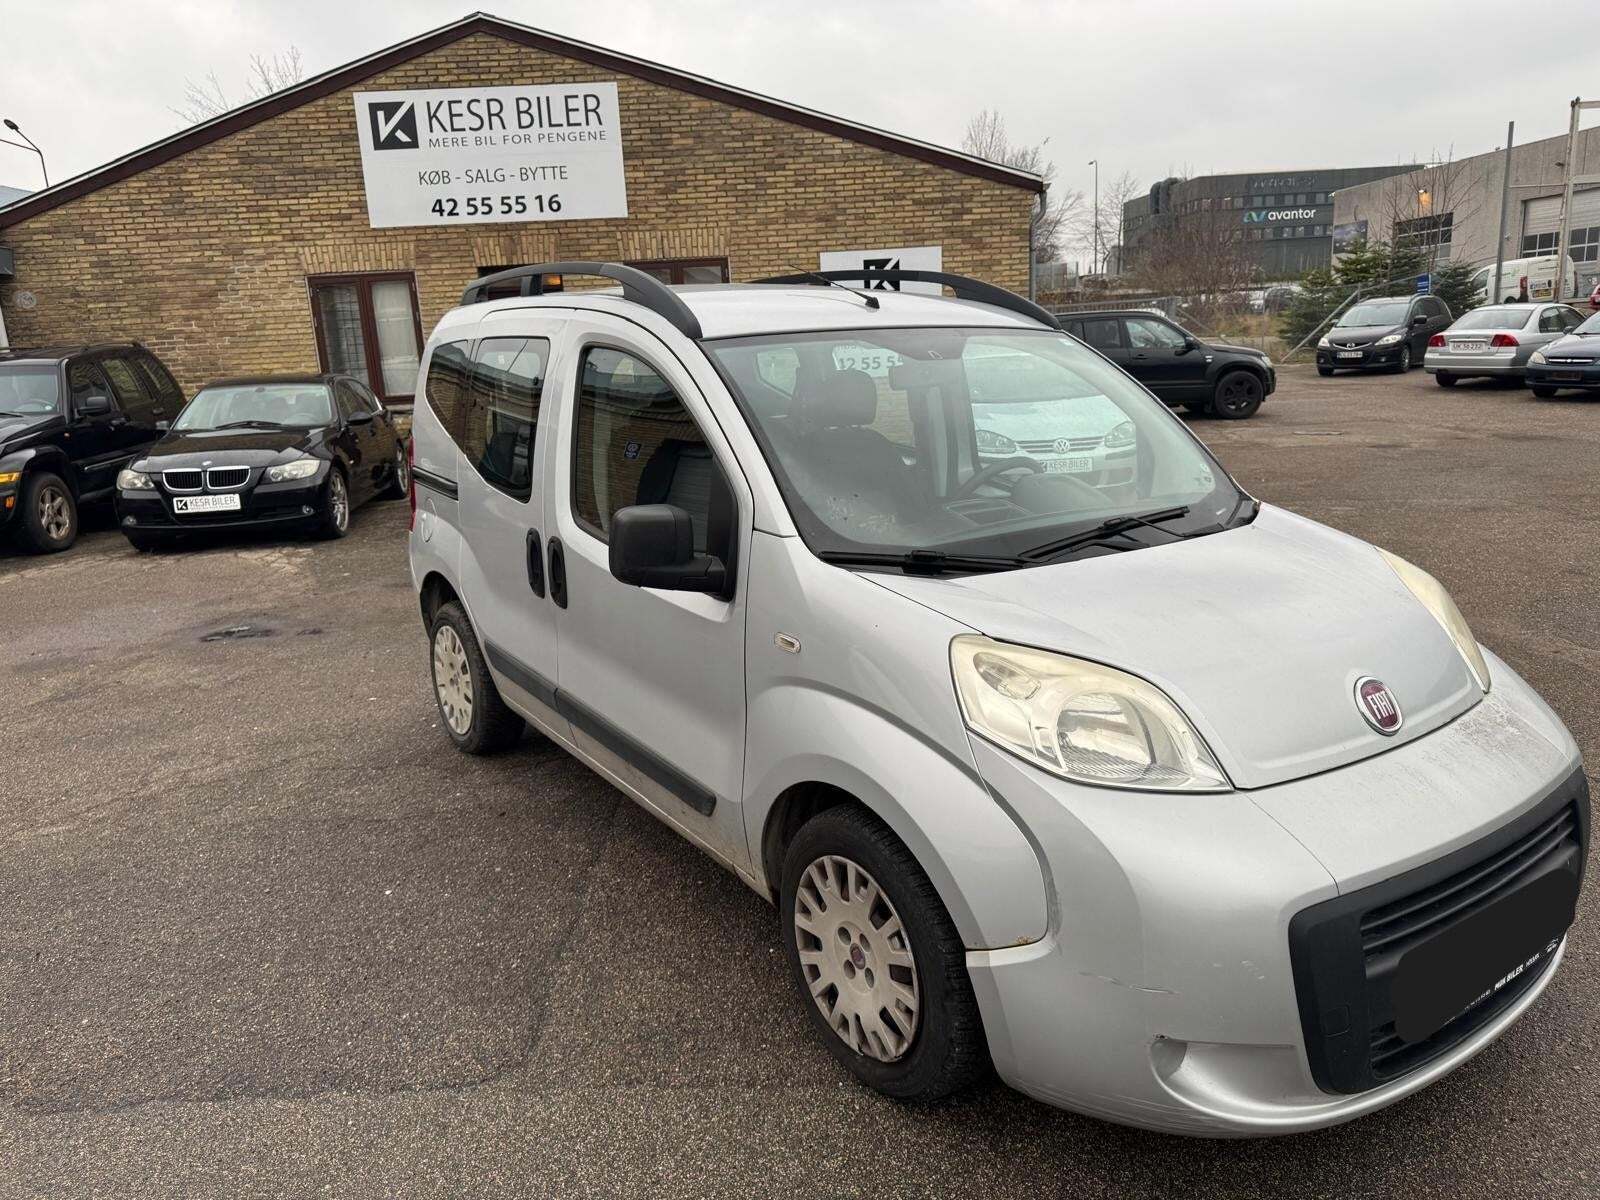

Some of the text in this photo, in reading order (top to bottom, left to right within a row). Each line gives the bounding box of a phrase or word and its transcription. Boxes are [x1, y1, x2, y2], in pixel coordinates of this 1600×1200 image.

[426, 93, 603, 133] KESR BILER
[428, 130, 607, 148] MERE BIL FOR PENGENE
[418, 169, 451, 186] KØB
[465, 168, 506, 184] SALG
[519, 165, 569, 182] BYTTE
[431, 193, 562, 217] 42 55 55 16
[1267, 208, 1316, 221] avantor
[861, 356, 881, 370] 55
[189, 498, 211, 507] KESR
[212, 496, 236, 506] BILER
[1366, 690, 1395, 720] FIAT
